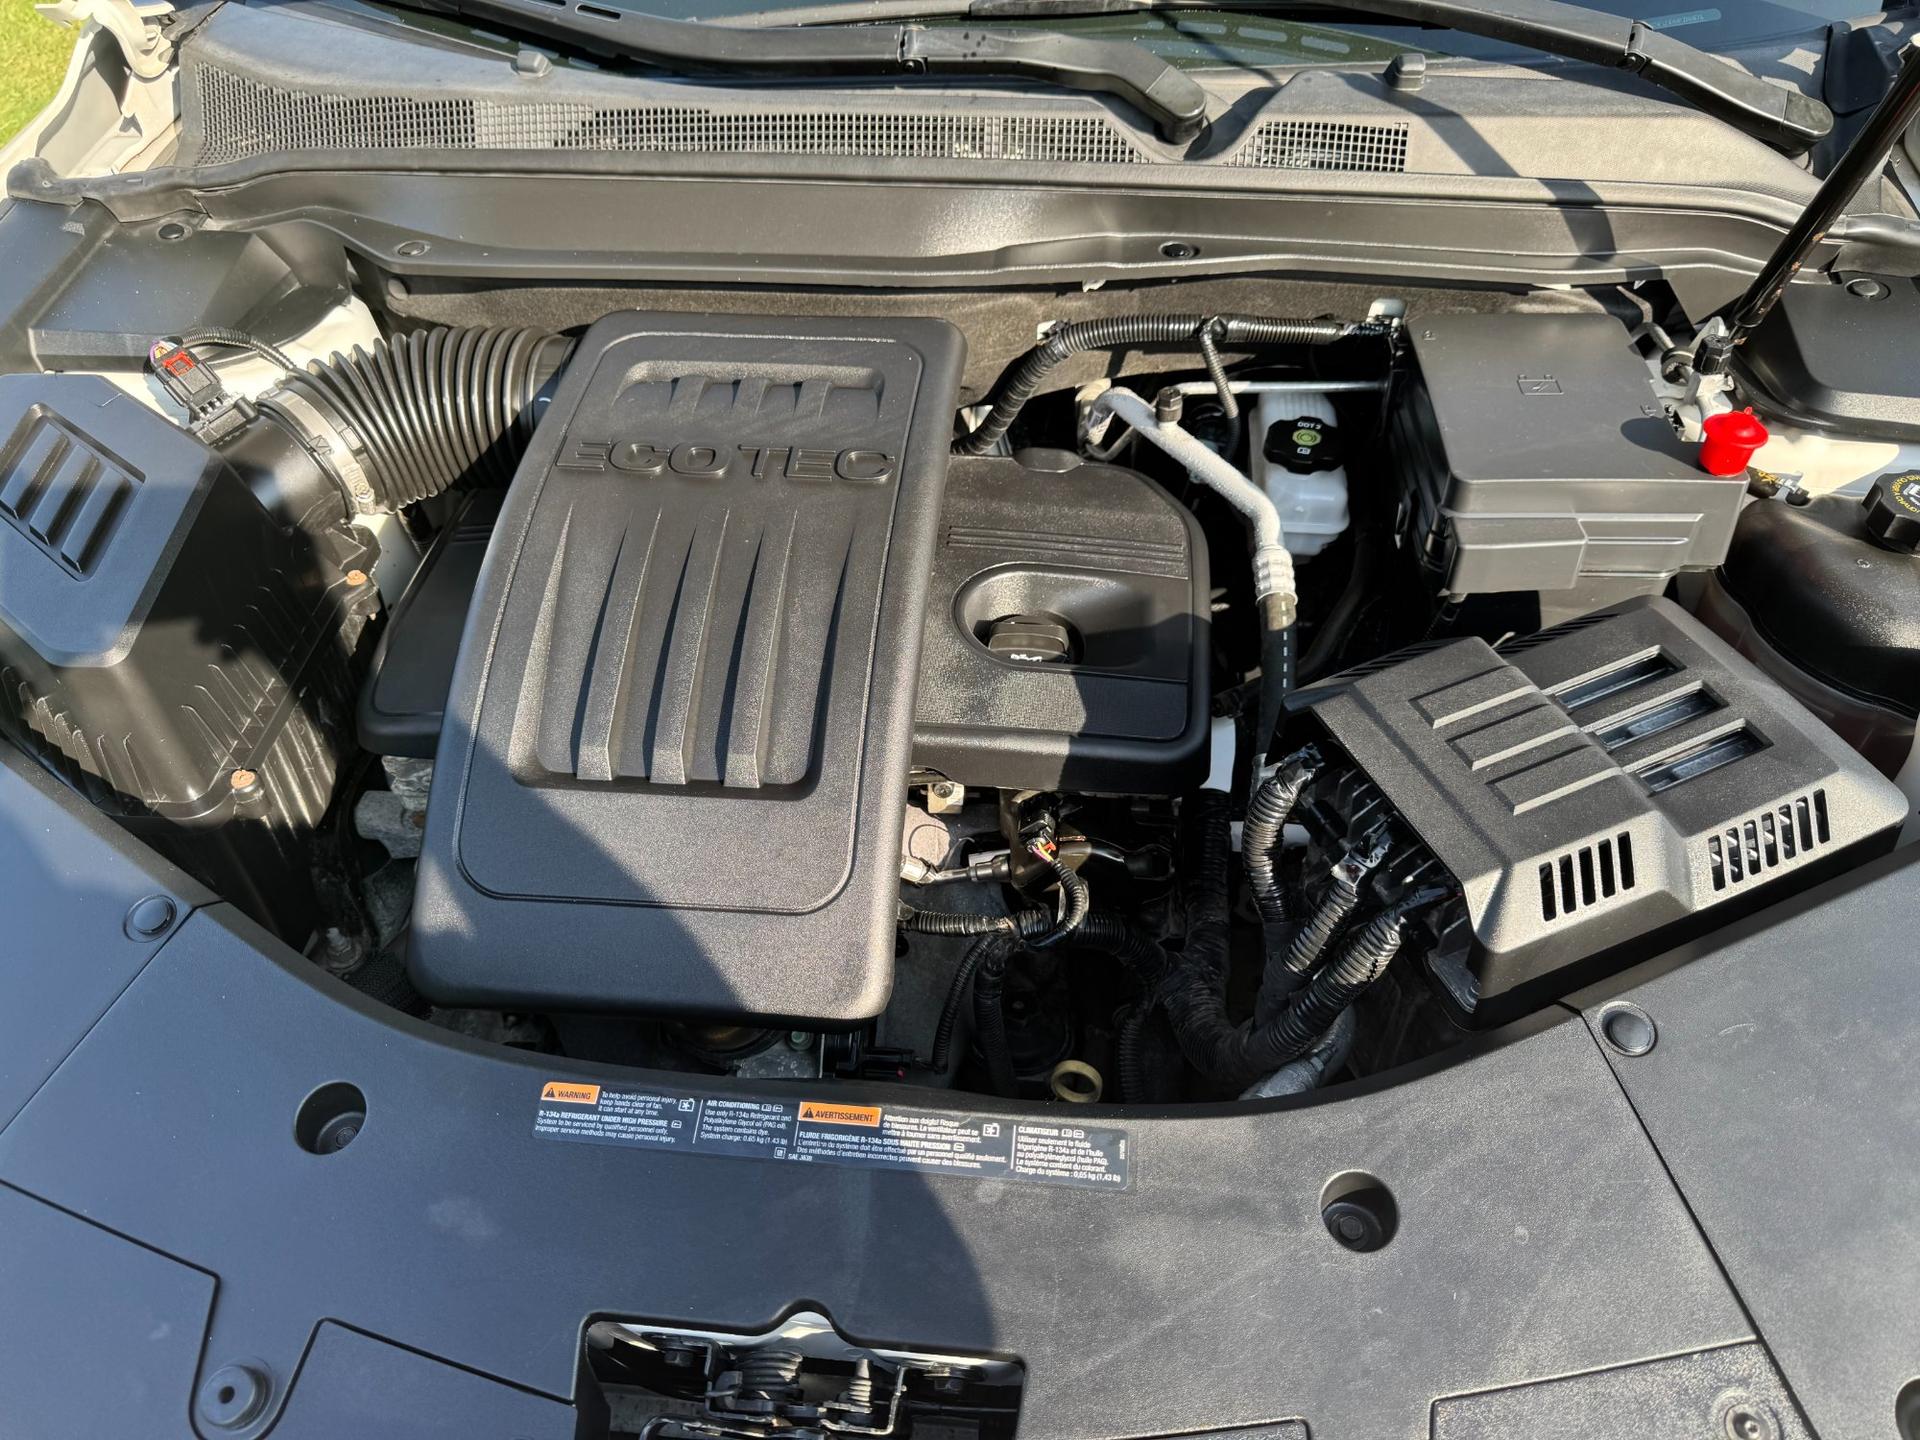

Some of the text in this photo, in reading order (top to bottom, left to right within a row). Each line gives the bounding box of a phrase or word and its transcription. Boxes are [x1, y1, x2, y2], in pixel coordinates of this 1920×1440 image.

[555, 439, 896, 482] ECOTEC
[558, 1090, 592, 1100] WARNING
[601, 1091, 677, 1105] To help avoid personal injury.
[614, 1099, 630, 1107] hands
[652, 1102, 663, 1110] fan.
[718, 1101, 760, 1110] CONDITIONING
[538, 1110, 669, 1127] R-134a REFRIGERANT UNDER HIGH PRESSURE
[703, 1116, 737, 1125] Polyalkylene
[737, 1119, 755, 1127] Glycol
[716, 1110, 729, 1118] only
[750, 1112, 781, 1121] Refrigerant
[815, 1110, 873, 1122] AVERTISSEMENT
[883, 1114, 909, 1123] Attention
[536, 1117, 557, 1125] System
[572, 1120, 596, 1128] serviced
[596, 1122, 604, 1130] by
[604, 1123, 628, 1131] qualified
[627, 1125, 655, 1134] personnel
[702, 1123, 770, 1137] The system contains dye.
[882, 1121, 891, 1129] de
[1018, 1126, 1059, 1137] CLIMATISEUR
[535, 1125, 560, 1133] Improper
[560, 1127, 581, 1135] service
[580, 1129, 605, 1137] methods
[634, 1133, 660, 1142] personal
[659, 1135, 676, 1143] injury.
[700, 1131, 721, 1140] System
[721, 1133, 742, 1142] charge:
[756, 1136, 765, 1145] kg
[799, 1131, 820, 1139] FLUIDE
[820, 1132, 860, 1143] FRIGORIGÈNE
[882, 1138, 900, 1146] SOUS
[899, 1139, 921, 1148] HAUTE
[920, 1141, 952, 1151] PRESSION
[905, 1130, 927, 1138] tourner
[926, 1132, 942, 1140] sans
[808, 1147, 836, 1156] méthodes
[836, 1149, 867, 1158] d'entretien
[867, 1152, 899, 1161] incorrectes
[898, 1155, 922, 1163] peuvent
[921, 1157, 942, 1165] causer
[941, 1158, 953, 1166] des
[835, 1143, 860, 1151] système
[883, 1146, 907, 1154] effectué
[906, 1149, 918, 1157] par
[925, 1151, 954, 1159] personnel
[974, 1154, 1008, 1163] seulement.
[1048, 1145, 1070, 1154] R-134a
[1016, 1157, 1025, 1166] Le
[1024, 1159, 1049, 1168] système
[1048, 1161, 1073, 1170] contient
[1081, 1165, 1107, 1173] colorant.
[1015, 1165, 1037, 1175] Charge
[1036, 1167, 1046, 1175] du
[1087, 1172, 1096, 1181] kg
